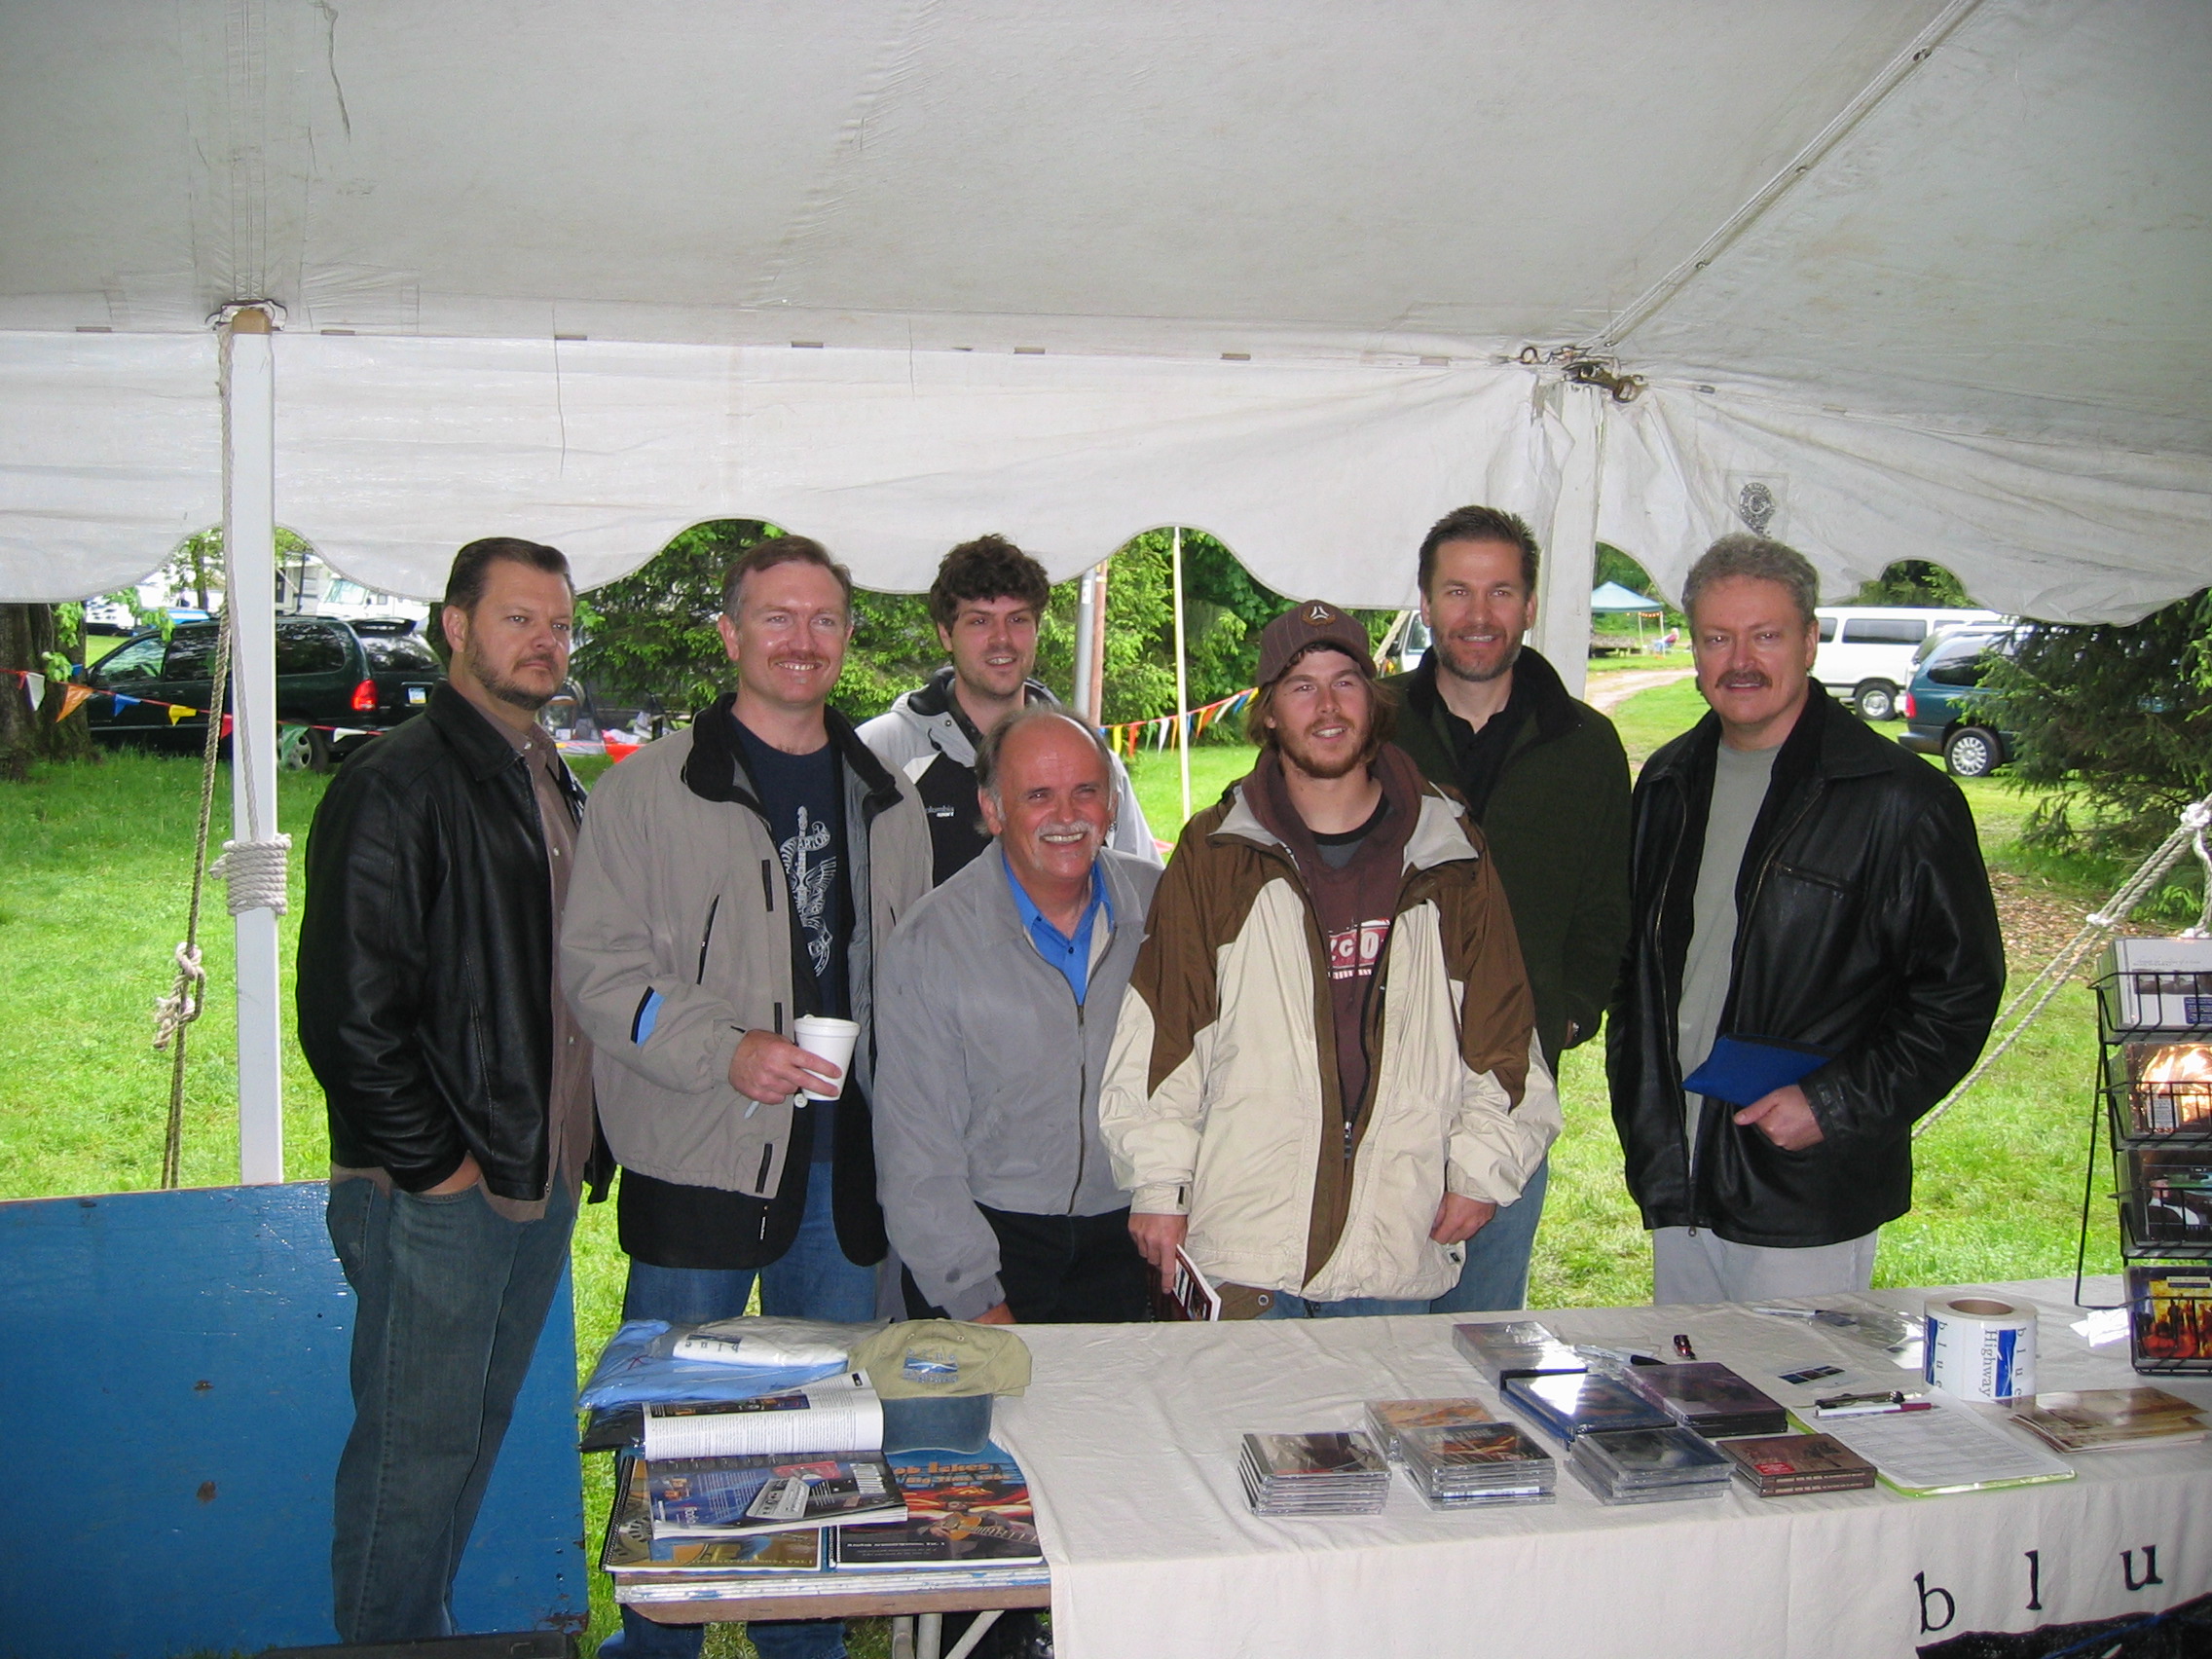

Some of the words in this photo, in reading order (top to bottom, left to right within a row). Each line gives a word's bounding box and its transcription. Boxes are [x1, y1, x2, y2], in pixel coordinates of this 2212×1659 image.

[1978, 1329, 1998, 1398] Highway
[2013, 1327, 2027, 1396] blue
[893, 1465, 921, 1475] ob
